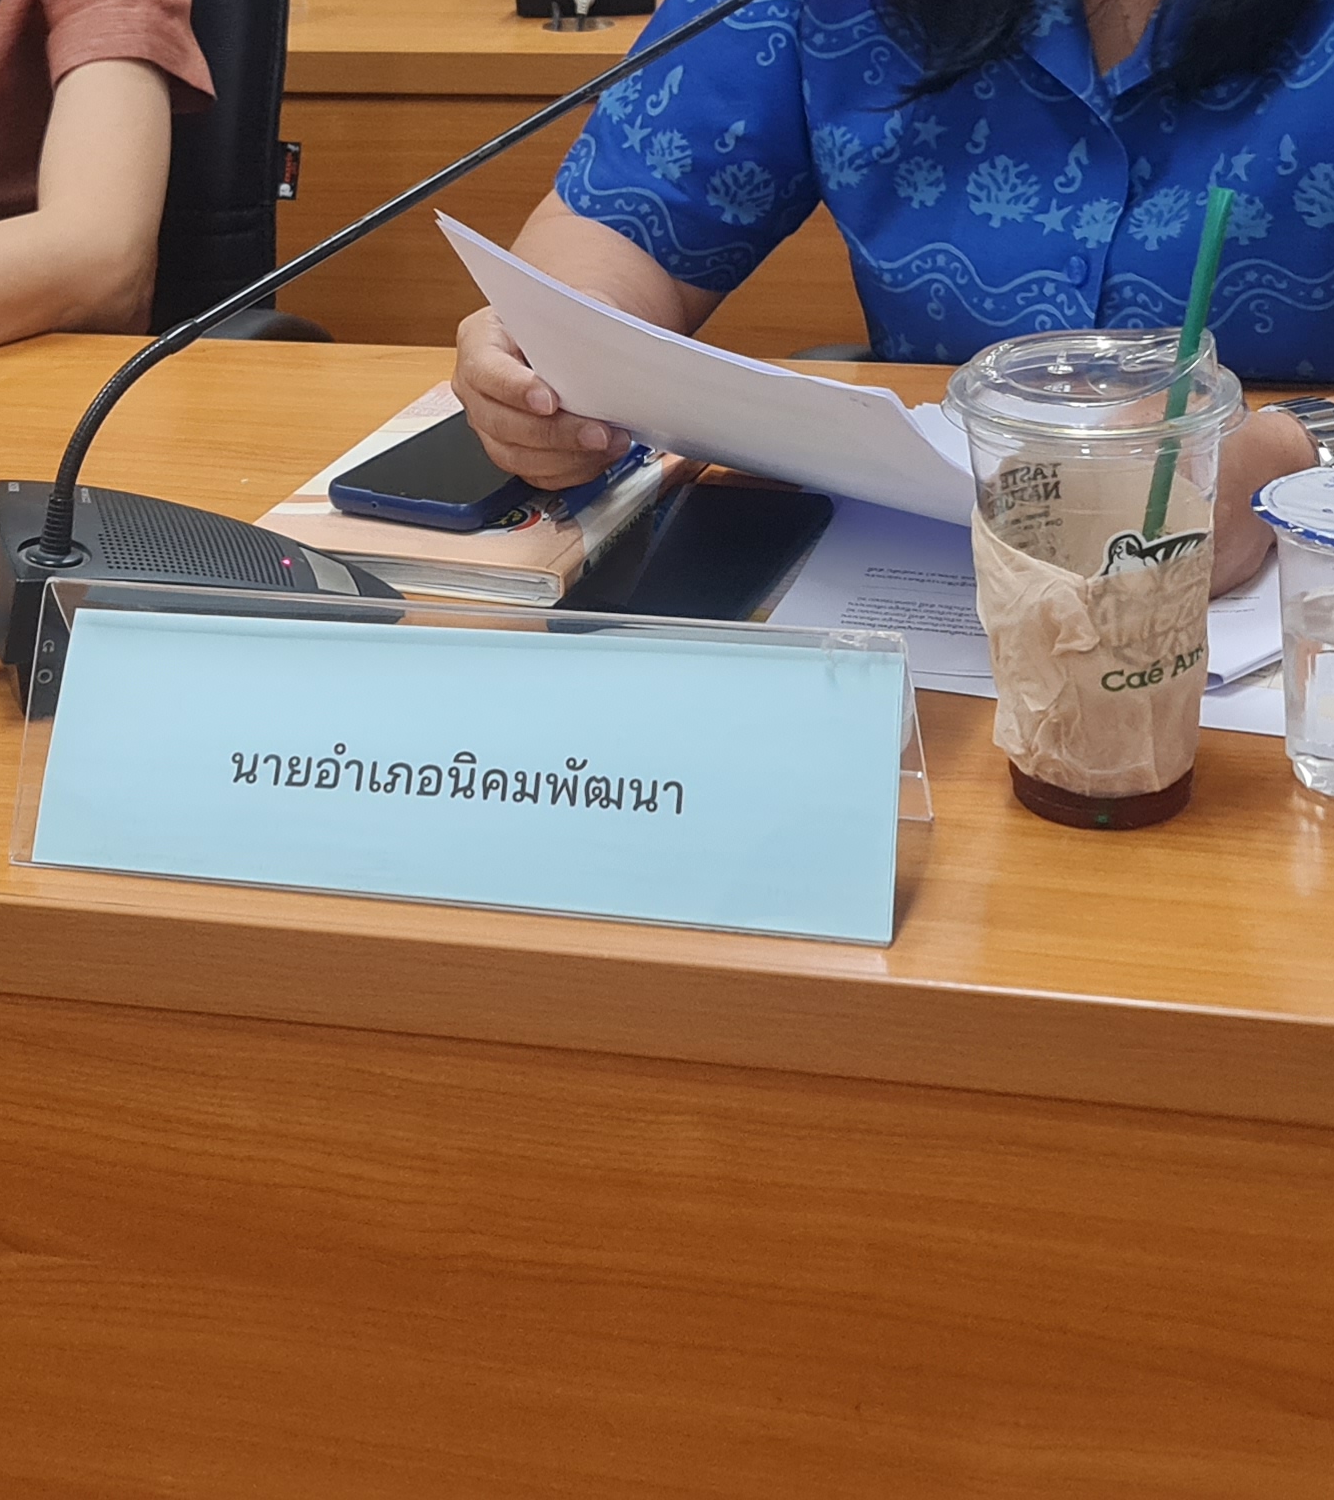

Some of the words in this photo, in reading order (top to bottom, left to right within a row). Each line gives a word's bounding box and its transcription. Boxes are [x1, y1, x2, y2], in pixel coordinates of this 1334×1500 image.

[231, 742, 685, 817] นายอำเภอนิคมพัฒนา
